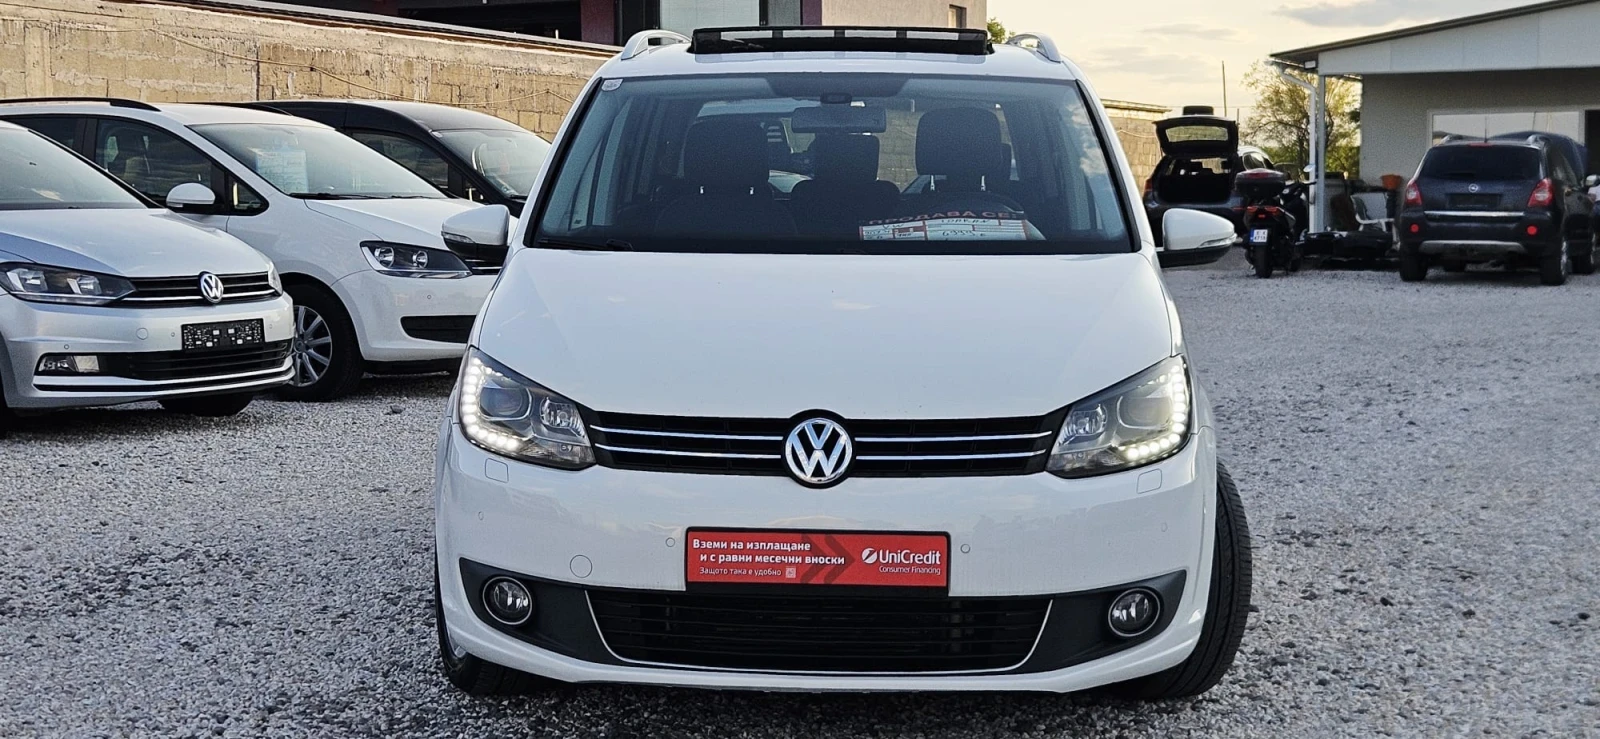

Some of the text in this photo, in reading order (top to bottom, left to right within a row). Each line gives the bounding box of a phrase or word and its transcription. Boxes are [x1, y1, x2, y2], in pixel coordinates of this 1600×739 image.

[787, 420, 850, 481] VW
[692, 539, 811, 552] Вземи на изплащане
[700, 553, 845, 565] и с равни месечни вноски
[879, 549, 941, 565] UniCredit
[700, 567, 728, 575] Защото
[754, 568, 782, 577] удобно
[879, 565, 941, 575] Consumer Financing
